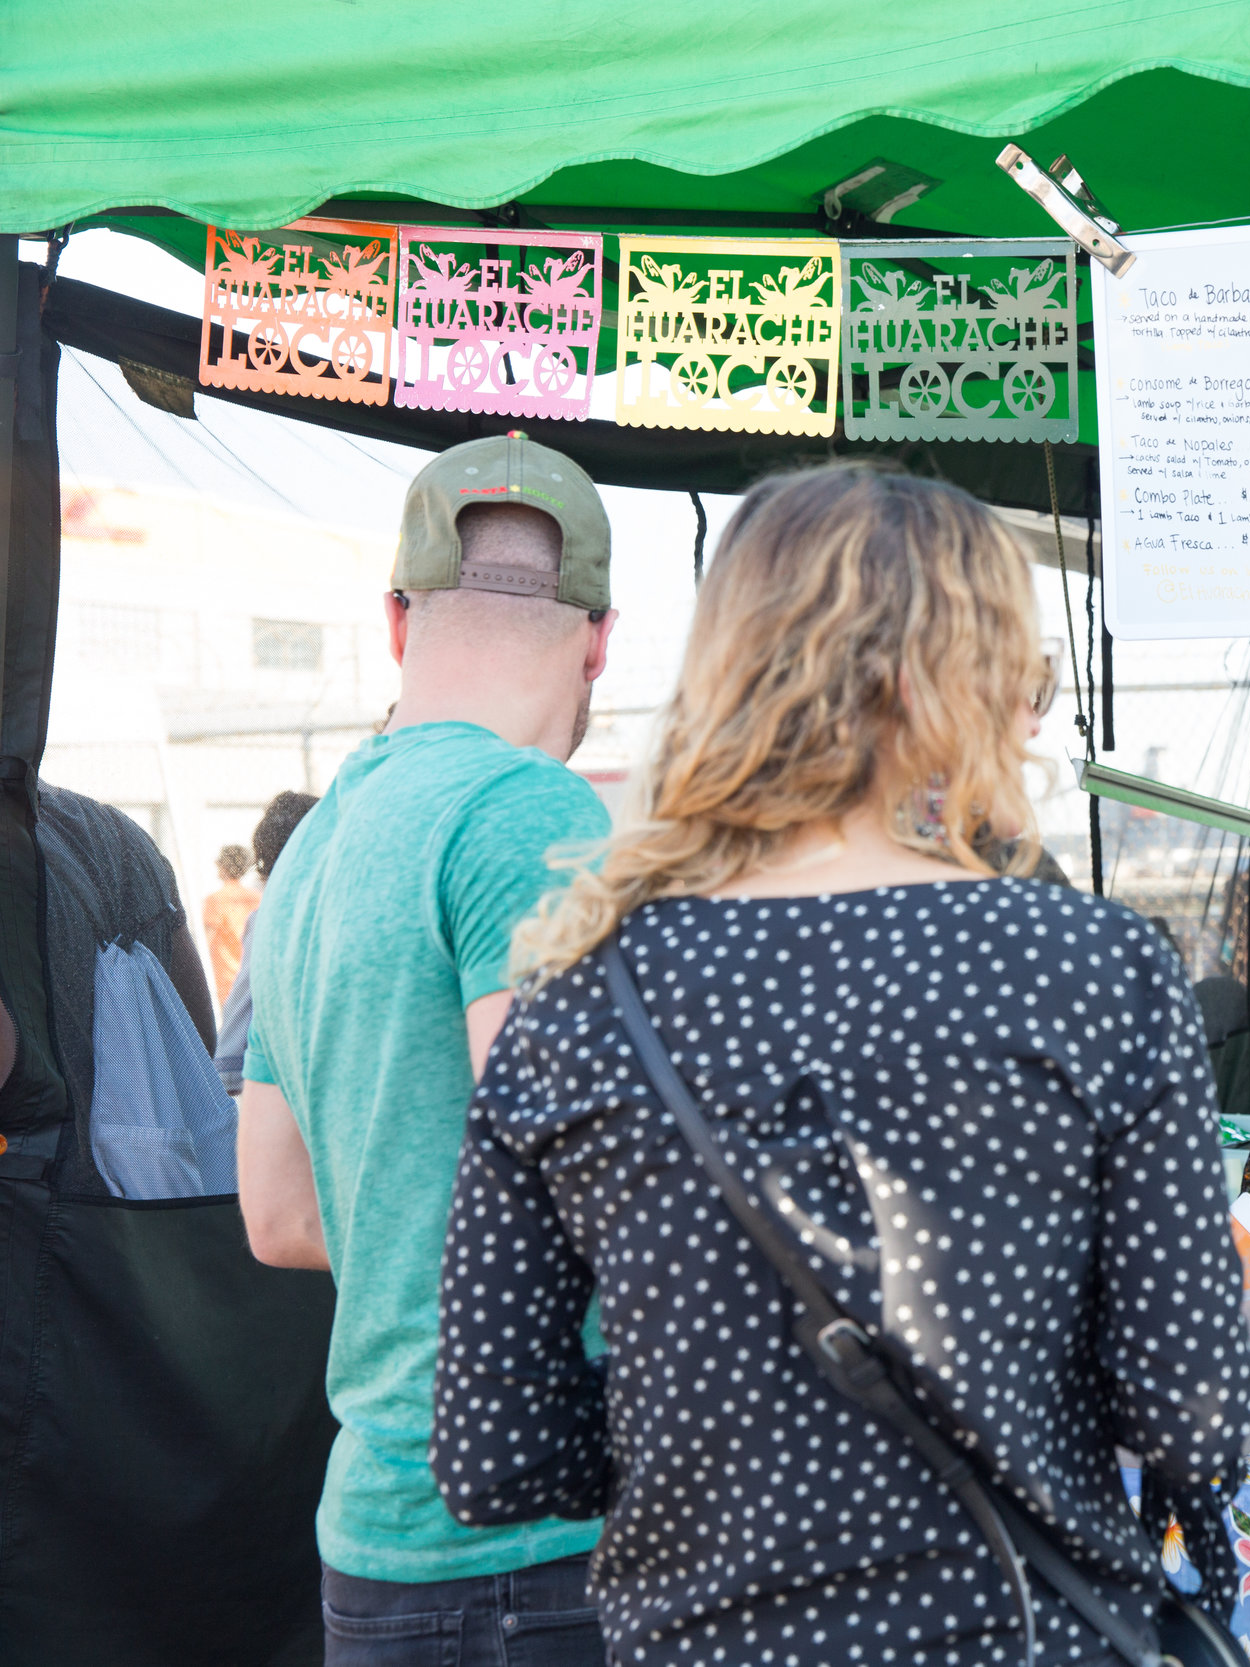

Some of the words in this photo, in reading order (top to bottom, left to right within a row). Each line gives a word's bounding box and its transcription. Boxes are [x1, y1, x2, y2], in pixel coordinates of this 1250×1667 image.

[281, 244, 318, 279] EL
[478, 258, 519, 294] EL
[211, 282, 388, 321] HUARACHE
[706, 269, 751, 304] EL
[932, 274, 980, 311] EL
[1139, 288, 1177, 309] Taco
[406, 299, 594, 334] HUARACHE
[627, 312, 832, 346] HUARACHE
[1132, 327, 1164, 338] tortilla
[1165, 313, 1178, 322] on
[1183, 313, 1190, 321] a
[1195, 312, 1248, 323] handmade
[216, 318, 373, 380] LOCO
[851, 317, 1069, 352] HUARACHE
[413, 336, 577, 398] LOCO
[637, 351, 816, 409] LOCO
[864, 360, 1056, 419] LOCO
[1160, 400, 1182, 413] soup
[1131, 434, 1159, 448] Taco
[1184, 438, 1234, 455] Nopales
[1166, 455, 1187, 464] salad
[1171, 469, 1194, 478] salsa
[1134, 487, 1177, 504] Combo
[1138, 508, 1145, 521] 1
[1176, 511, 1200, 522] Taco
[1217, 511, 1227, 525] 1
